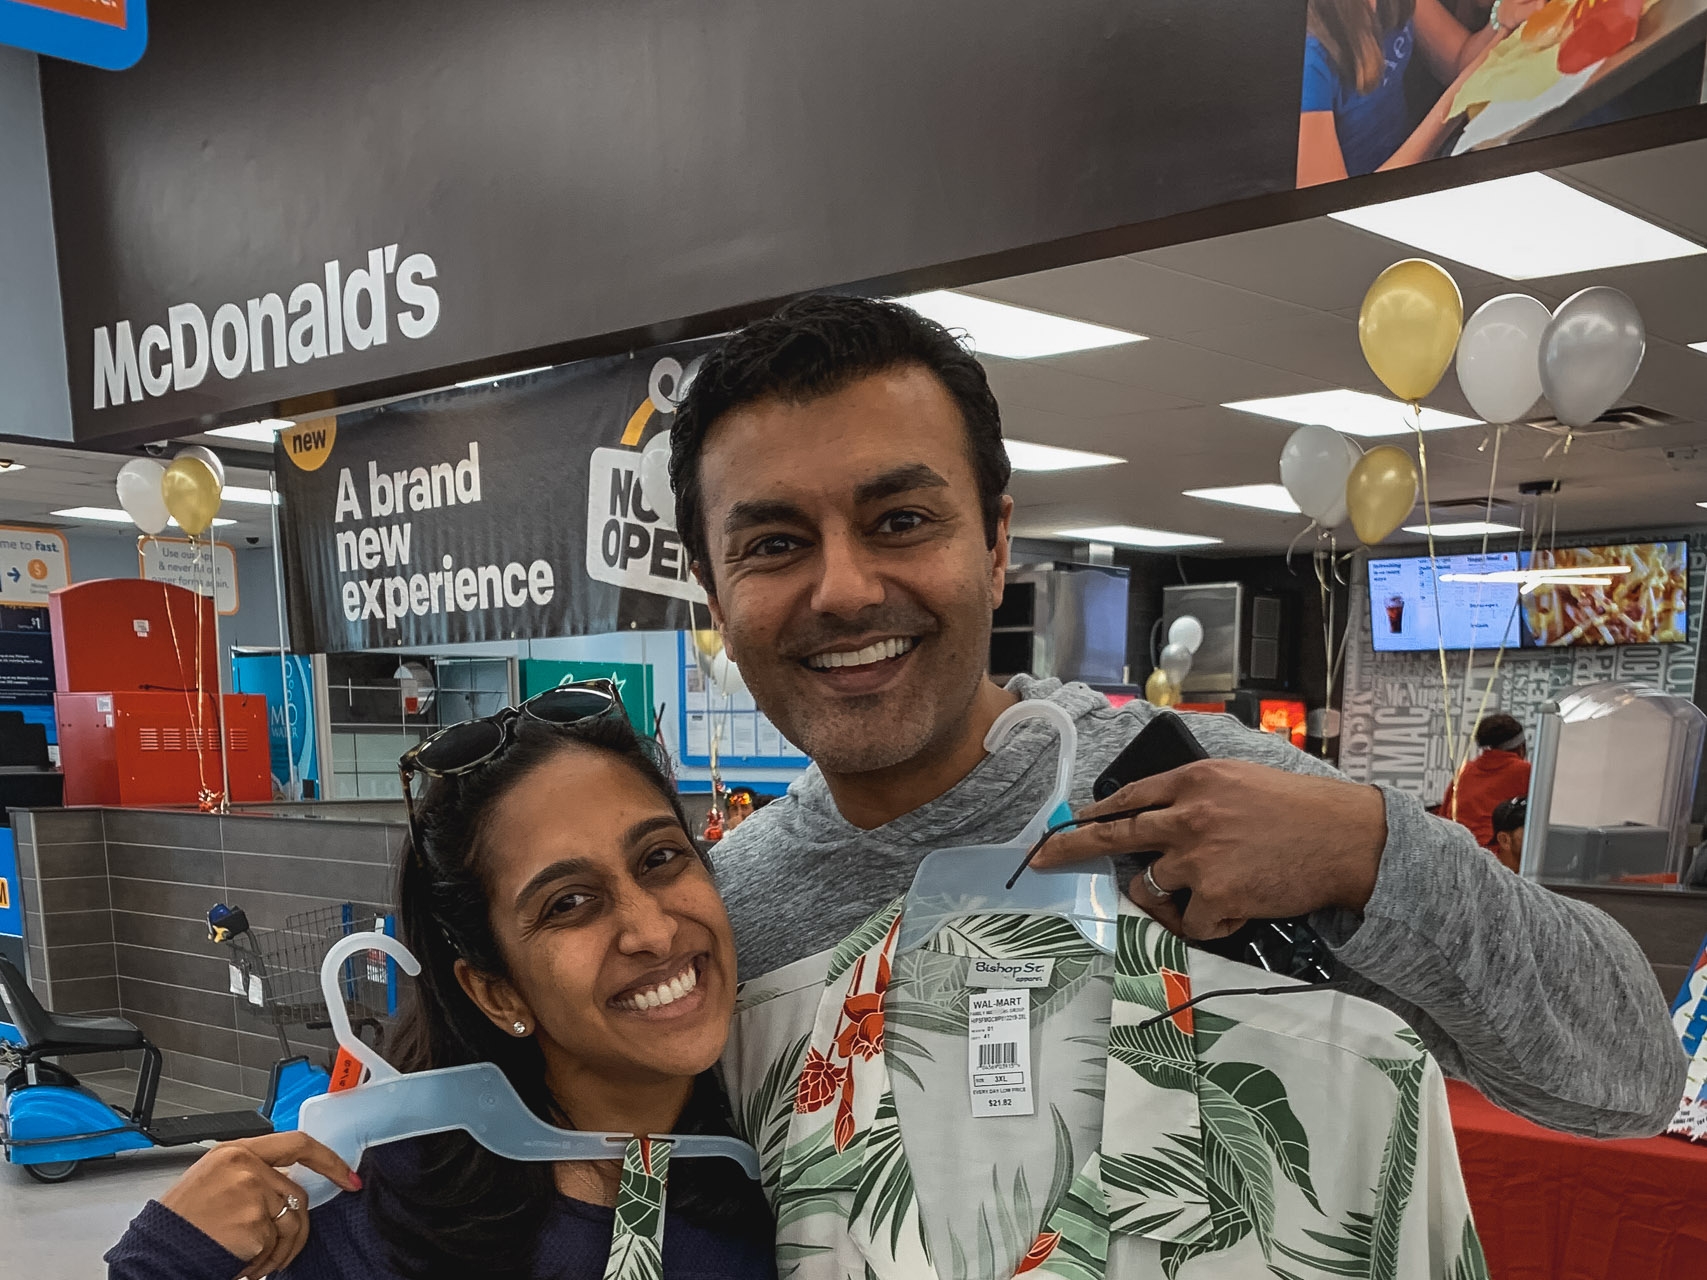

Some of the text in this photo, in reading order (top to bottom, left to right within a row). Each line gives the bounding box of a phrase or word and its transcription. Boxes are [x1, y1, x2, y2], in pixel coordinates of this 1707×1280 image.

[94, 243, 440, 410] McDonald's
[293, 426, 326, 453] new
[335, 441, 482, 523] A brand
[162, 547, 179, 559] Use
[336, 522, 411, 572] new
[167, 563, 192, 573] never
[342, 554, 555, 629] experience
[976, 961, 1022, 978] Bishop
[973, 997, 1022, 1010] WAL-MART
[988, 1099, 1012, 1107] $21.82
